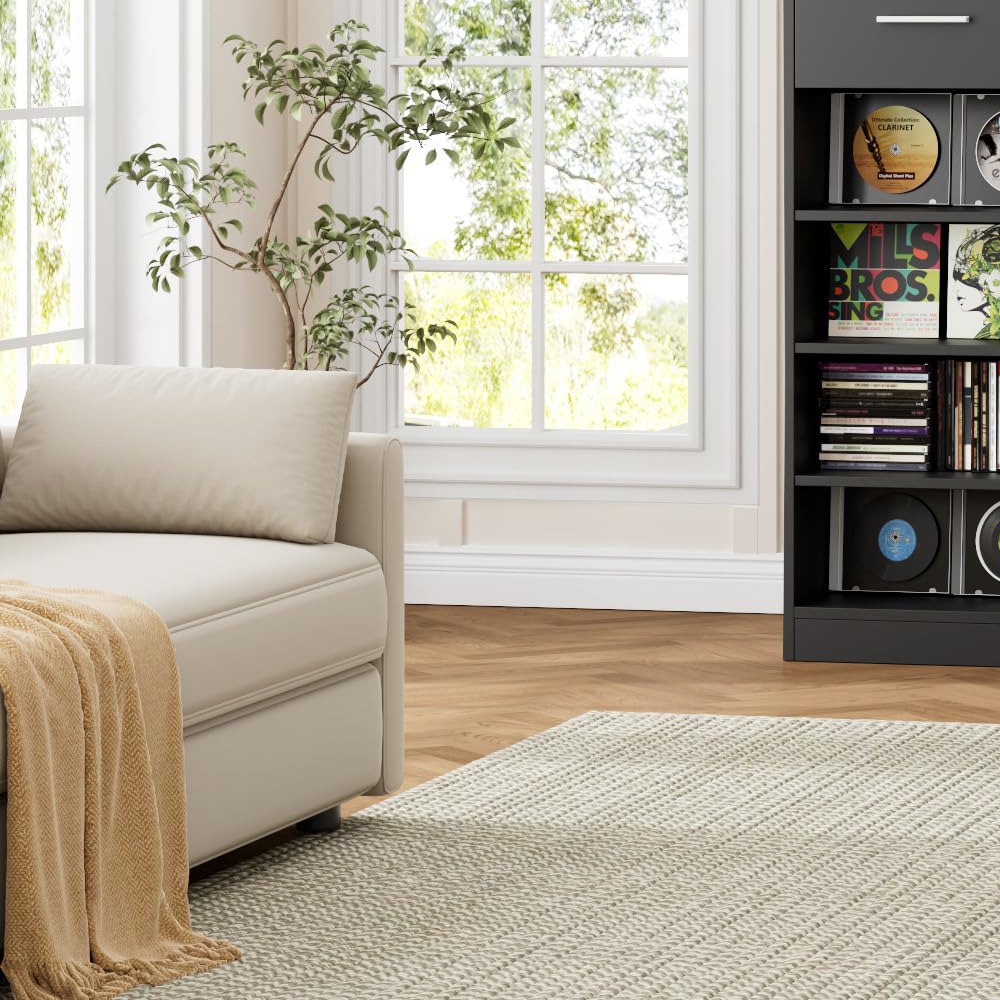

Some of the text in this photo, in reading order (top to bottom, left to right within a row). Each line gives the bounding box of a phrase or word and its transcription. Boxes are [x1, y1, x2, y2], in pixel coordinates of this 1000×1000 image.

[831, 224, 940, 269] MILLS
[830, 269, 936, 302] BROS.
[829, 302, 883, 320] SING
